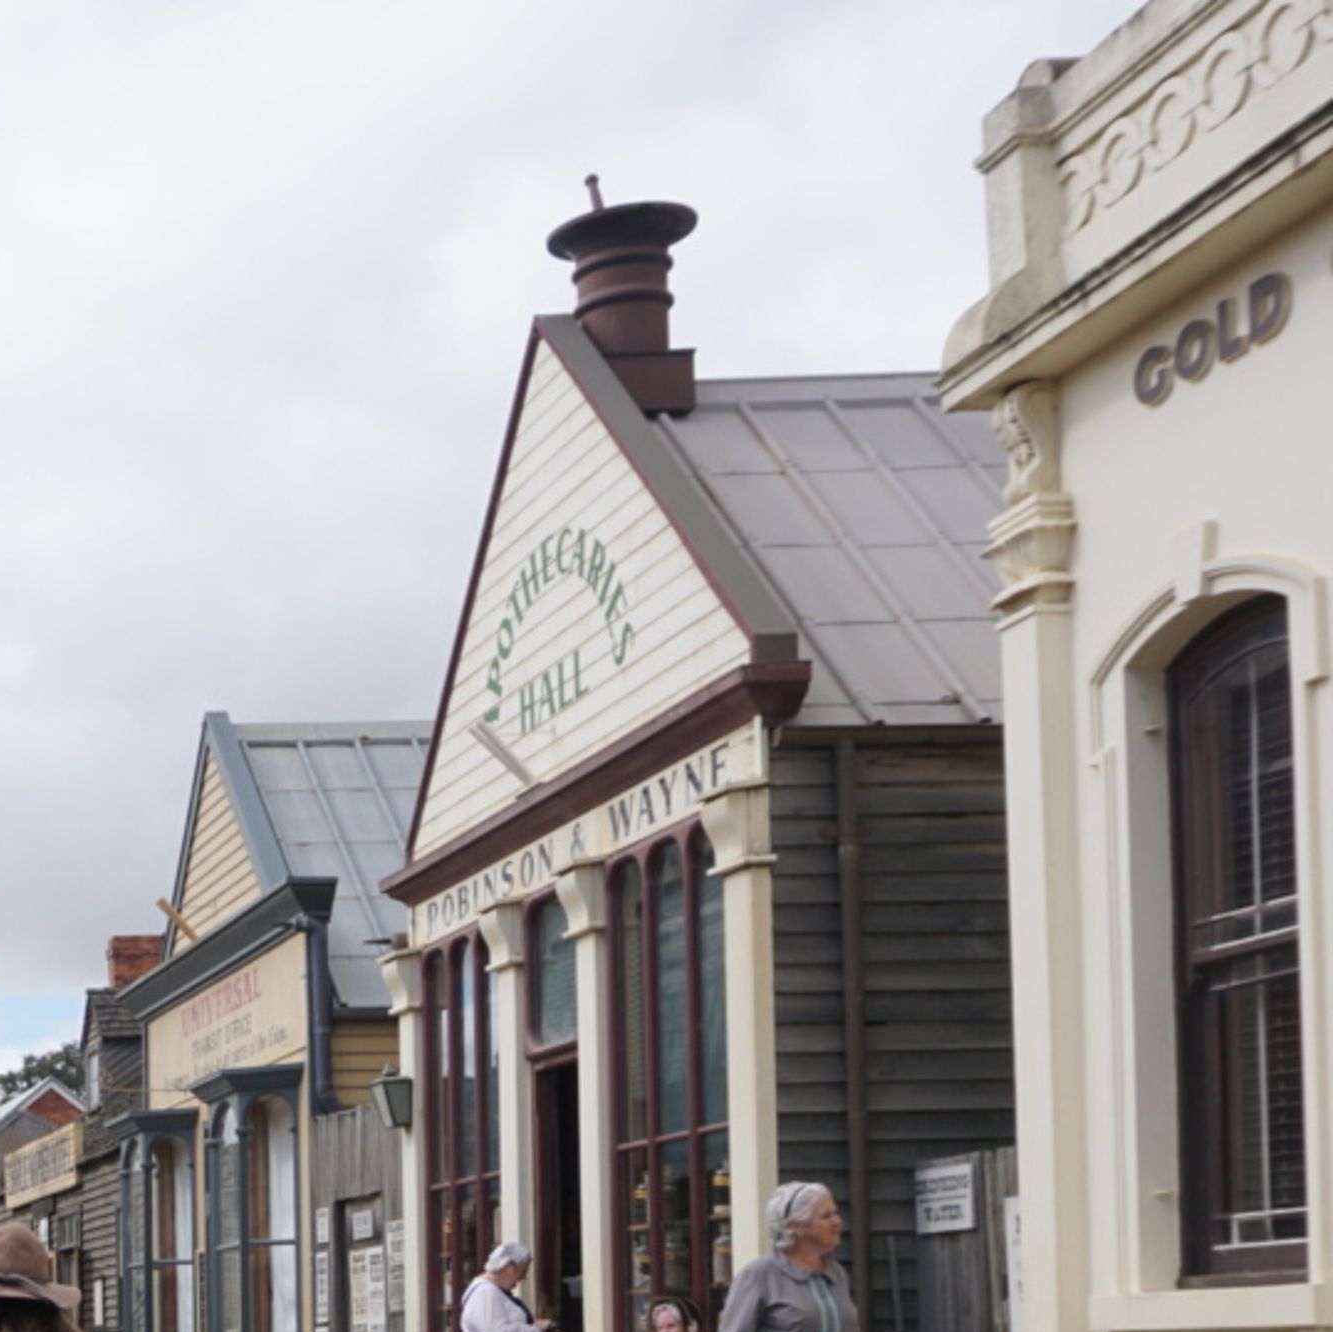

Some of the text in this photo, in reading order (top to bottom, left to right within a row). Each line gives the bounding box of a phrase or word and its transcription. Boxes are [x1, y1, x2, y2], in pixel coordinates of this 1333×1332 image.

[1134, 272, 1294, 410] GOLD
[520, 649, 590, 735] HALL
[568, 822, 590, 862] &
[182, 967, 263, 1038] UNIVERSAL
